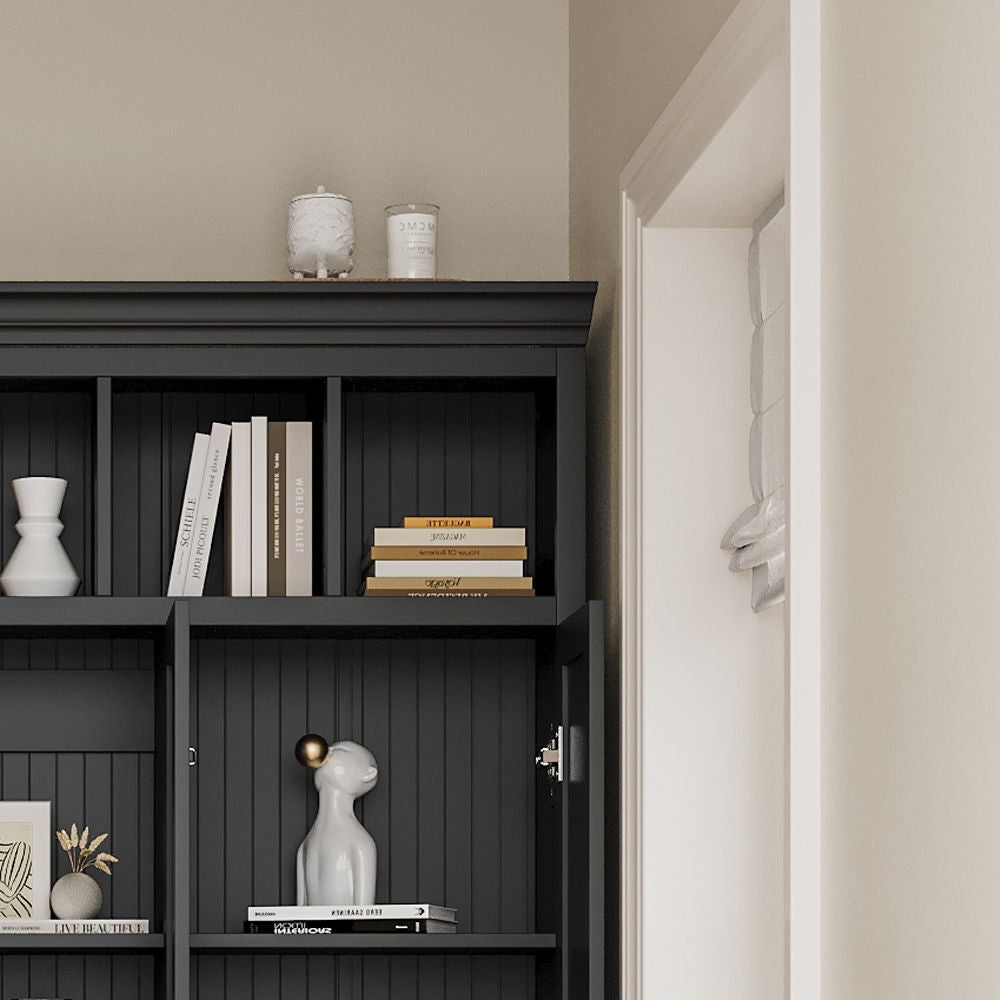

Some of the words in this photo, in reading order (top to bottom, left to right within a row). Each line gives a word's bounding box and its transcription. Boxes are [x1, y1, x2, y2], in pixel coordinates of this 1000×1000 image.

[295, 477, 304, 514] WORLD
[179, 497, 197, 547] SCHIELE
[295, 518, 304, 553] BALLET
[191, 558, 203, 580] JODI
[198, 516, 210, 556] PICOULT
[54, 923, 80, 934] LIVE
